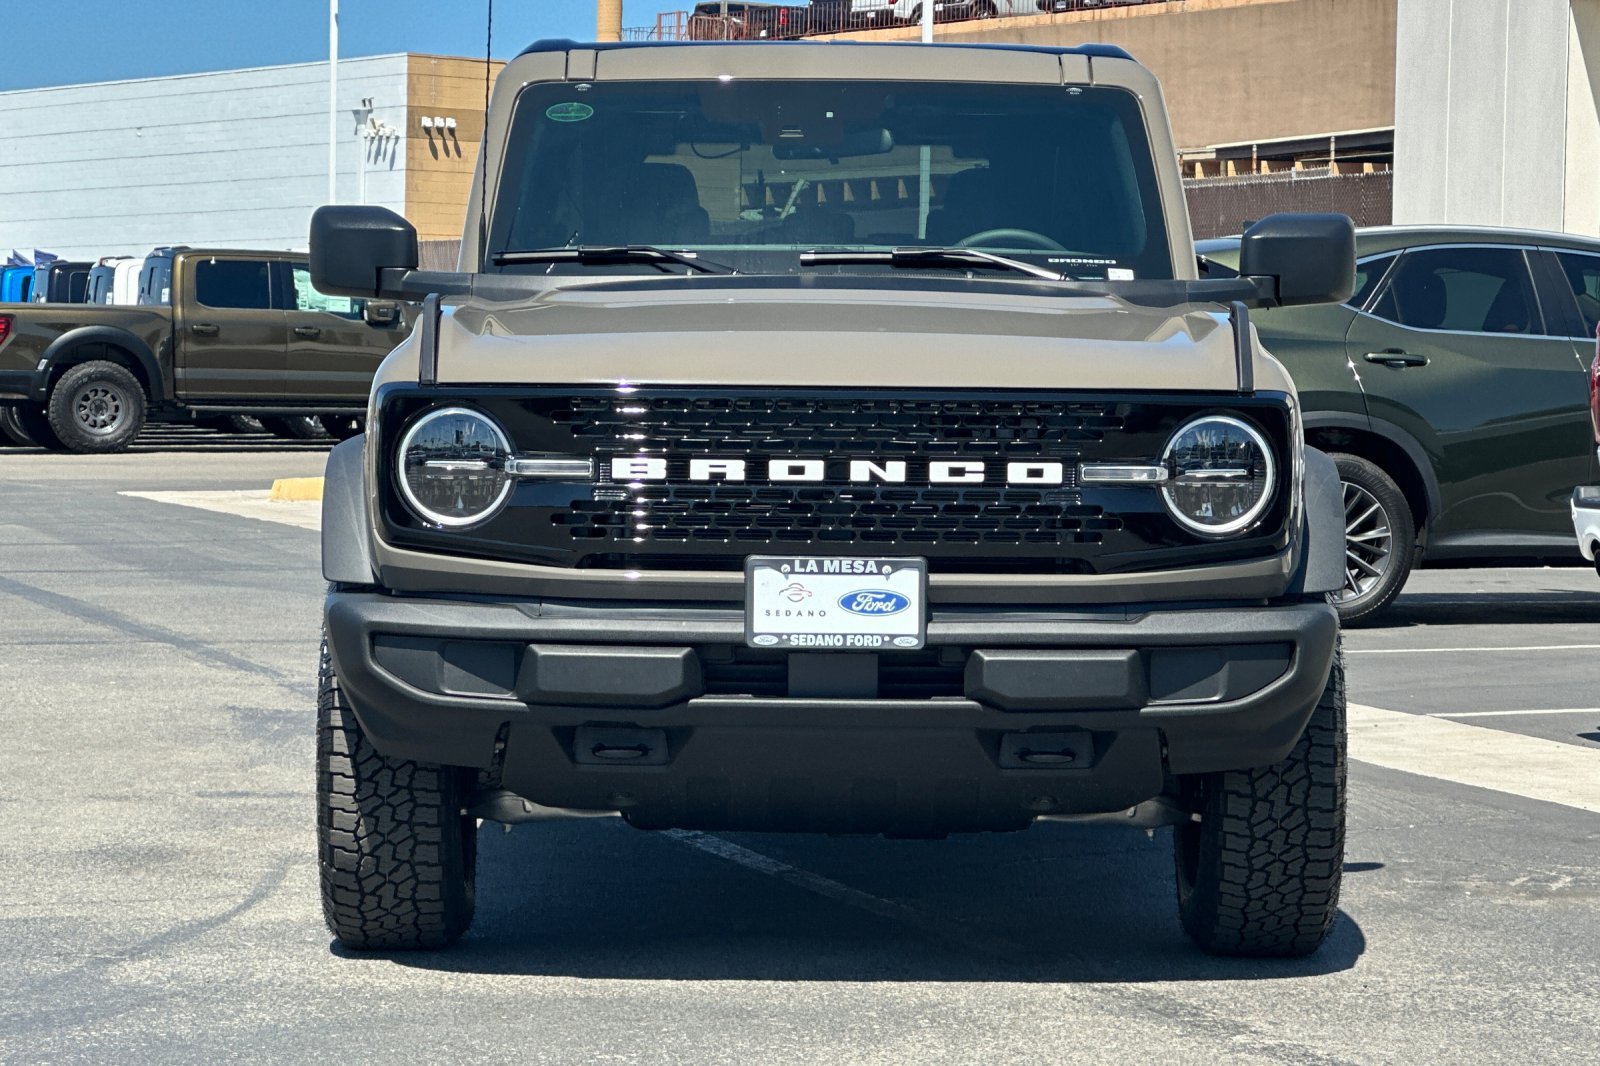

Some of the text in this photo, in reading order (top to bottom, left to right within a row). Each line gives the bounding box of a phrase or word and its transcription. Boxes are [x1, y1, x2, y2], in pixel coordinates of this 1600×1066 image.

[611, 457, 1063, 483] BRONCO
[794, 559, 878, 574] LA MESA
[851, 592, 897, 612] Ford
[764, 609, 827, 617] SEDANO
[789, 634, 883, 647] SEDANO FORD
